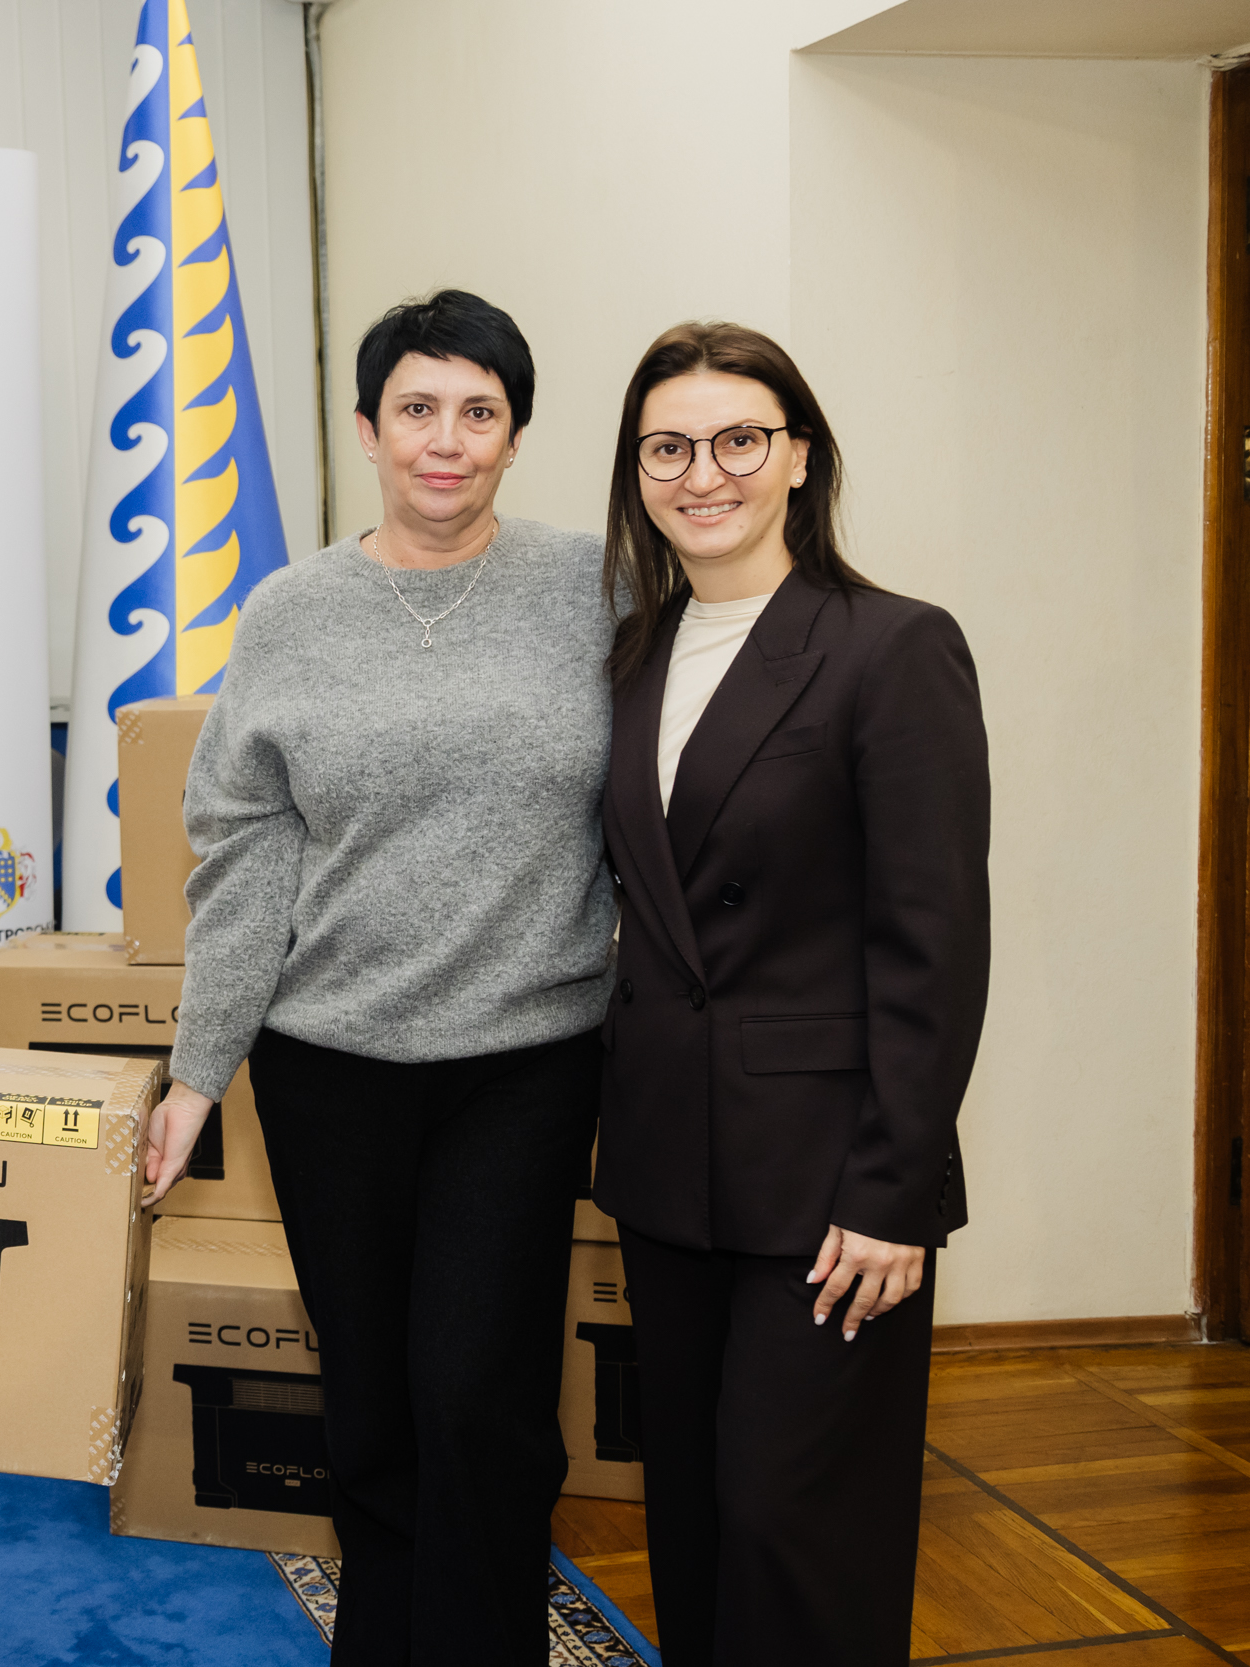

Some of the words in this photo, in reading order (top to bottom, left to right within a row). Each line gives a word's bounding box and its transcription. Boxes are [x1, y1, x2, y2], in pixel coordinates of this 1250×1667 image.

[41, 1002, 180, 1024] ECOFL
[0, 1131, 33, 1139] CAUTION
[54, 1136, 87, 1144] CAUTION
[188, 1322, 319, 1352] ECOFL
[246, 1462, 330, 1479] ECOFLO
